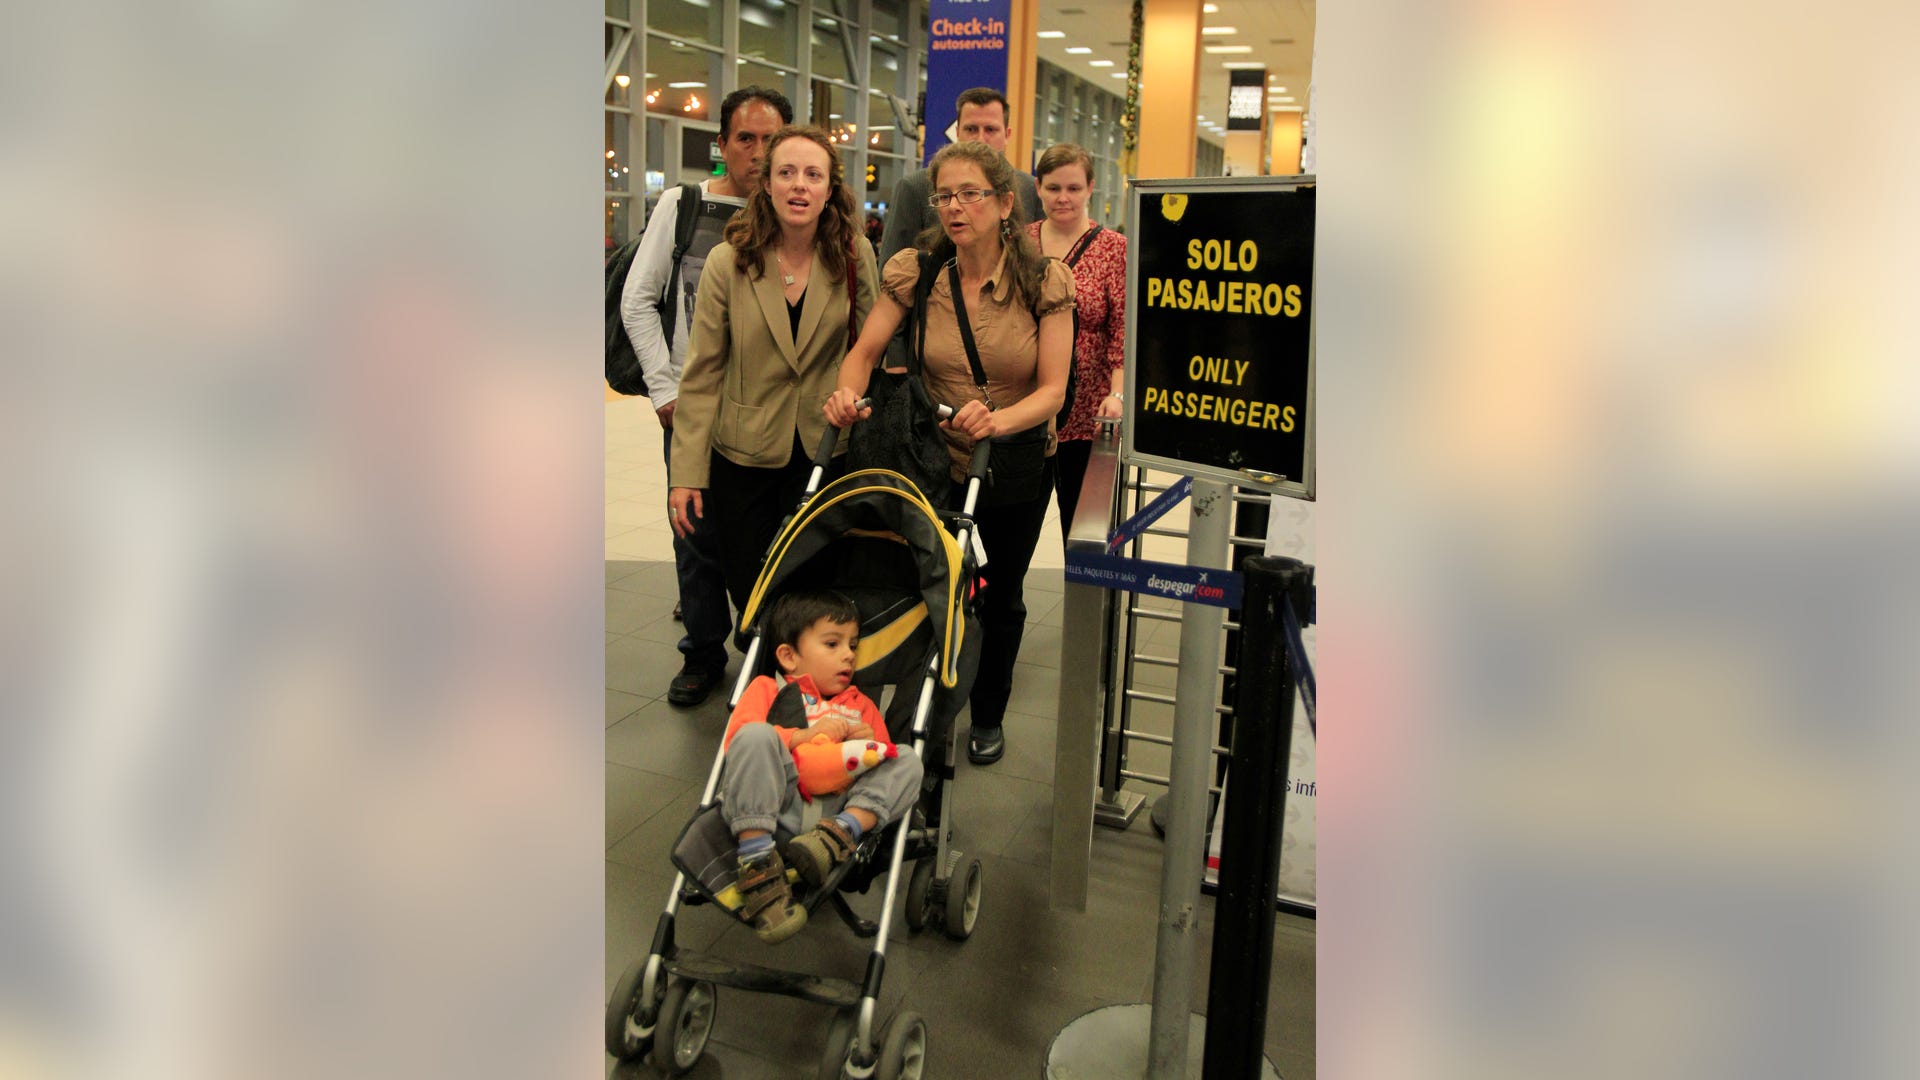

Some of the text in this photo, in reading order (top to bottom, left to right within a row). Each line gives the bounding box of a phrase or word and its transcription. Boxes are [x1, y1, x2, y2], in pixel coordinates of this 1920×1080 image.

[931, 17, 1004, 36] Check-in
[932, 37, 1004, 50] autoservicio
[1187, 238, 1258, 272] SOLO
[1147, 277, 1302, 317] PASAJEROS
[1189, 355, 1249, 386] ONLY
[1144, 387, 1296, 433] PASSENGERS
[1295, 778, 1316, 797] inf
